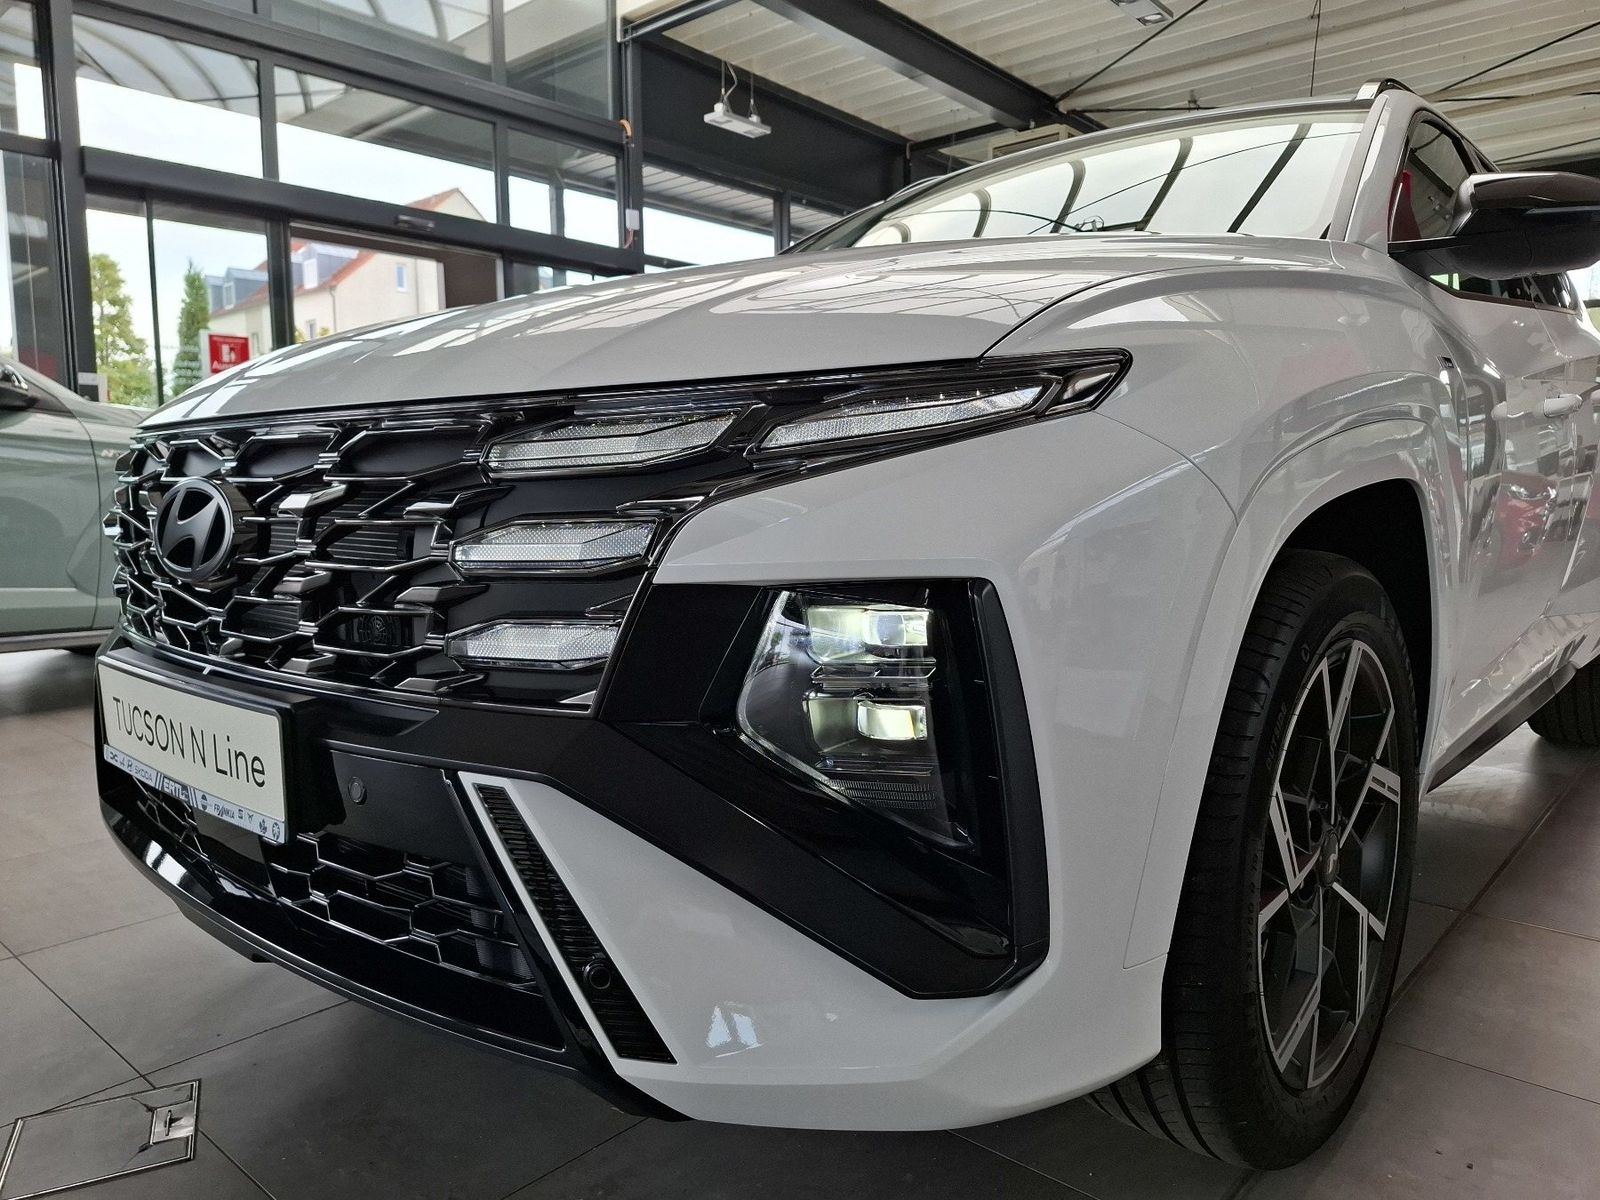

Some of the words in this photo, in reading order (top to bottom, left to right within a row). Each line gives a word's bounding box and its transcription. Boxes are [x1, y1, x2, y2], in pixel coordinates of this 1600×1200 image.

[113, 696, 185, 759] TUCSON
[190, 726, 207, 768] N
[213, 733, 266, 788] Line
